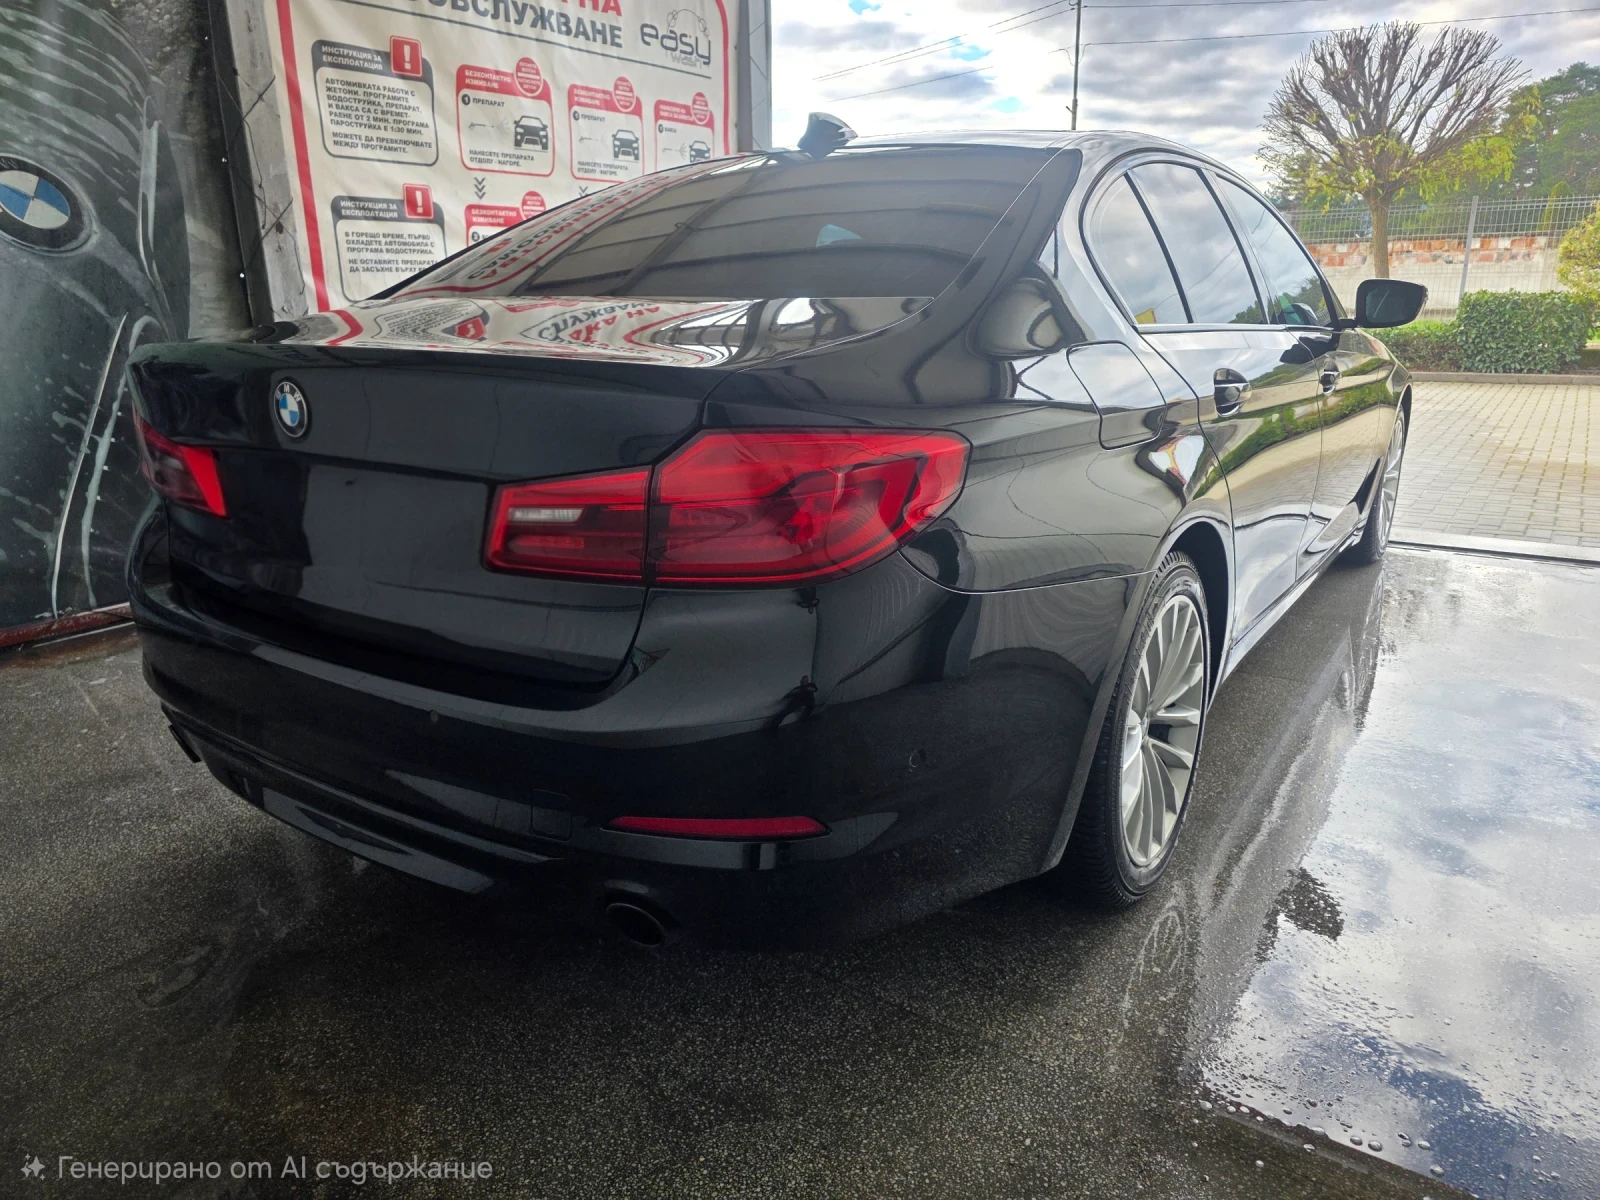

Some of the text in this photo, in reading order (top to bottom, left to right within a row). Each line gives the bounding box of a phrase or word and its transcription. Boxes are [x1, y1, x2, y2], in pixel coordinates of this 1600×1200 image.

[640, 23, 711, 65] easy
[322, 45, 383, 62] ИНСТРУКЦИЯ ЗА
[322, 55, 383, 70] ЕКСПЛОАТАЦИЯ
[464, 69, 512, 83] БЕЗКОНТАКТНО
[325, 77, 381, 91] АВТОМИВКАТА
[382, 86, 409, 96] РАБОТИ
[465, 78, 499, 89] ИЗМИВАНЕ
[325, 85, 409, 103] ЖЕТОНИ. ПРОГРАМИТЕ
[326, 94, 423, 114] ВОДОСТРУЙКА, ПРЕПАРАТ,
[335, 103, 360, 113] ВАКСА
[472, 97, 505, 107] ПРЕПАРАТ
[329, 110, 353, 120] РАЕНЕ
[372, 116, 391, 125] МИН.
[392, 118, 430, 129] ПРОГРАМА
[330, 118, 382, 131] ПАРОСТРУЙКА
[390, 126, 405, 134] 1:30
[406, 127, 424, 136] МИН.
[332, 131, 433, 149] МОЖЕТЕ ДА ПРЕВКЛЮЧВАТЕ
[333, 140, 409, 154] МЕЖДУ ПРОГРАМИТЕ.
[469, 149, 535, 161] НАНЕСЕТЕ ПРЕПАРАТА
[469, 157, 494, 165] ОТДОЛУ
[340, 200, 388, 210] ИНСТРУКЦИЯ
[341, 208, 398, 219] ЕКСПЛОАТАЦИЯ
[471, 208, 517, 217] БЕЗКОНТАКТНО
[351, 231, 381, 239] ГОРЕЩО
[407, 233, 431, 241] ПЪРВО
[345, 239, 383, 247] ОХЛАДЕТЕ
[383, 240, 429, 248] АВТОМОБИЛА
[346, 246, 384, 254] ПРОГРАМА
[359, 258, 400, 266] ОСТАВЯЙТЕ
[275, 382, 302, 402] BMW
